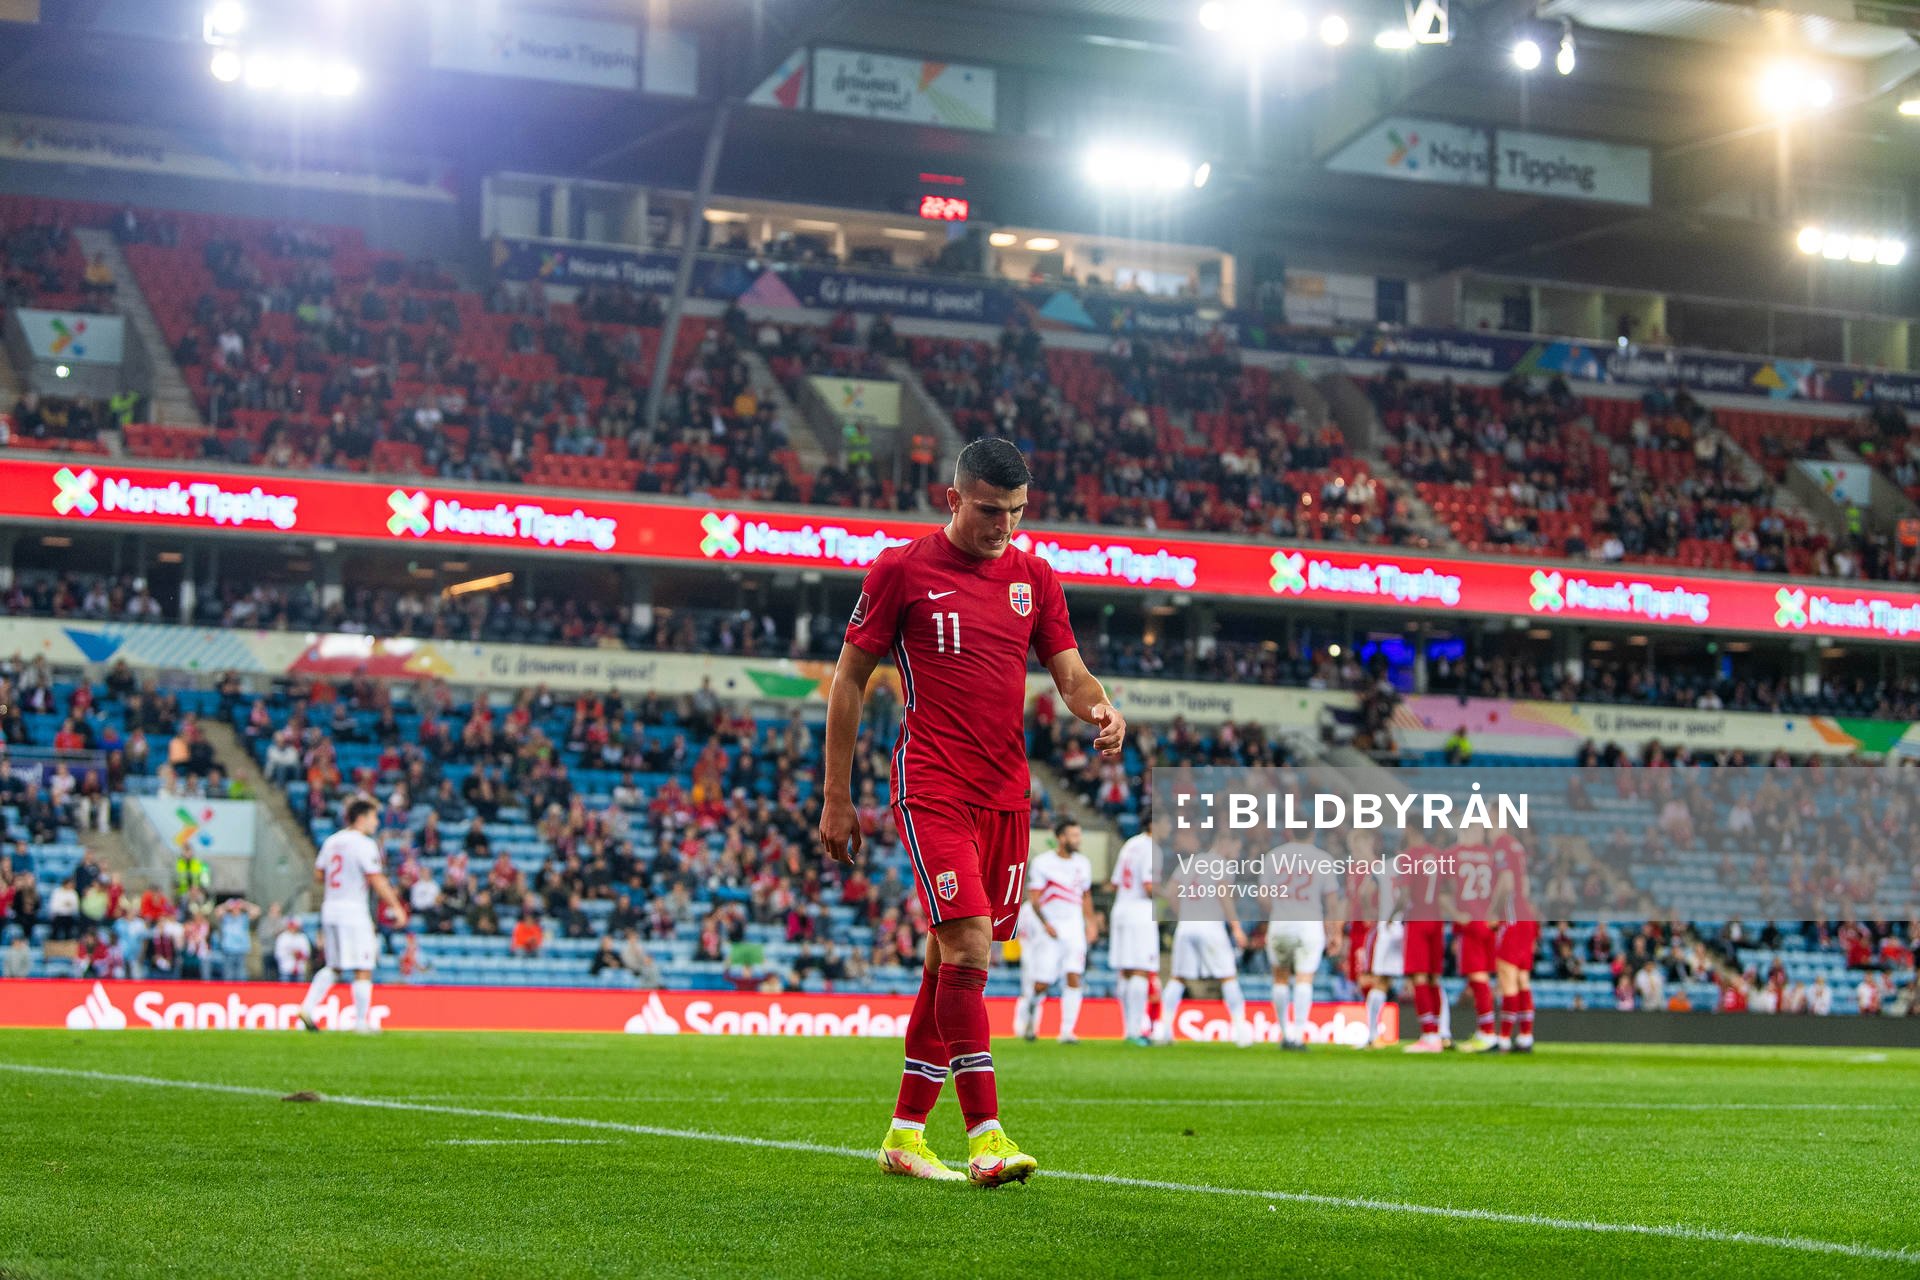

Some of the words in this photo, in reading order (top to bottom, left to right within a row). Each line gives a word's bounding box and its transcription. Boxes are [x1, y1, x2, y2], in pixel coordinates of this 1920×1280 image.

[1505, 149, 1597, 193] Tipping
[102, 477, 190, 516] Norsk
[189, 482, 298, 530] Tipping
[433, 499, 516, 537] Norsk
[514, 504, 617, 550] Tipping
[743, 521, 821, 558] Norsk
[1106, 545, 1197, 588] Tipping
[1307, 559, 1378, 594] Norsk
[1375, 563, 1462, 606] Tipping
[1566, 578, 1631, 612] Norsk
[1628, 582, 1710, 624] Tipping
[1809, 595, 1871, 628] Norsk
[931, 612, 961, 655] 11
[329, 854, 344, 889] 2
[1003, 862, 1025, 906] 11
[1458, 863, 1493, 900] 23
